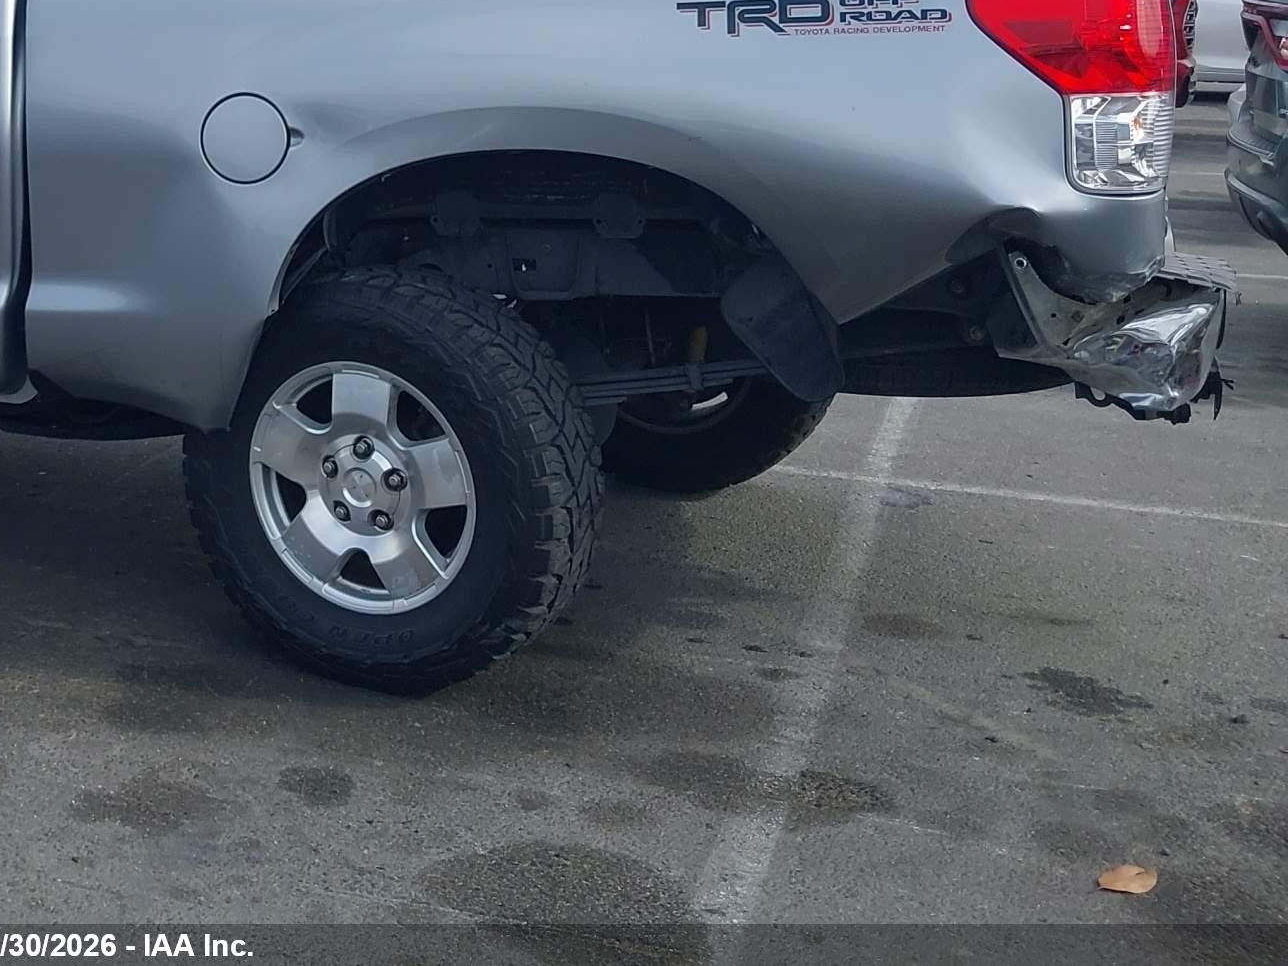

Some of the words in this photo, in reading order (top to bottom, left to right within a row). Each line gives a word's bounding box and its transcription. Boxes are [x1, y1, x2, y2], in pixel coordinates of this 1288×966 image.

[839, 8, 952, 26] ROAD
[794, 28, 830, 36] TOYOTA
[834, 26, 870, 35] RACING
[873, 24, 946, 34] DEVELOPMENT
